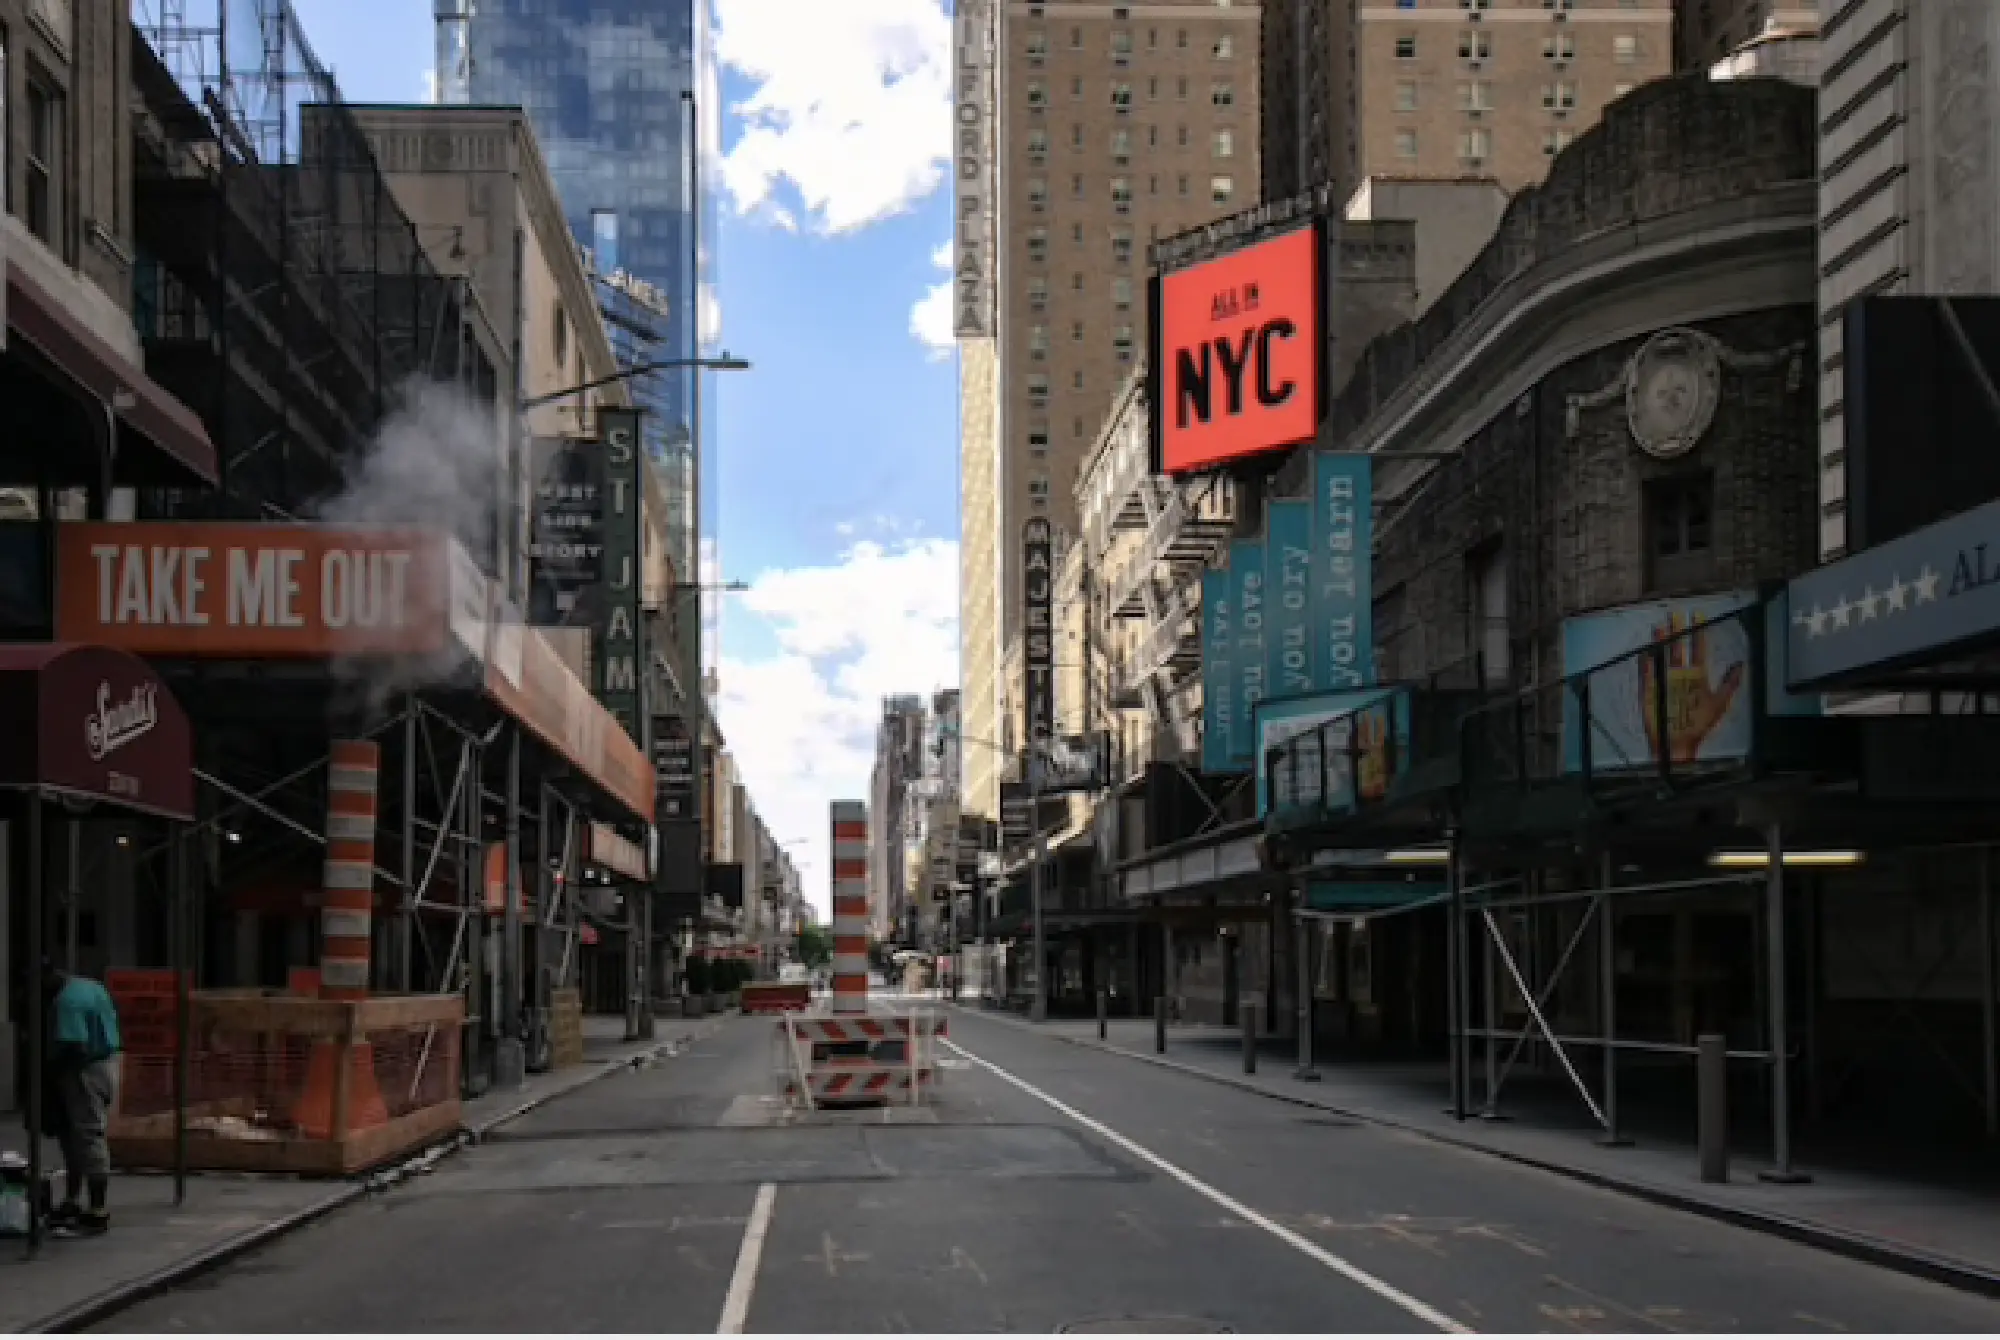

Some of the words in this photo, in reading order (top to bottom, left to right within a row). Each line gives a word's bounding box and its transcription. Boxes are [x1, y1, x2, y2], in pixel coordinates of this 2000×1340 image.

[956, 0, 982, 180] MILFORD
[956, 195, 983, 331] PLAZA
[1175, 317, 1297, 430] NYC
[90, 543, 212, 625] TAKE
[225, 547, 305, 627] ME
[320, 549, 411, 628] OUT
[1323, 475, 1356, 599] learn
[605, 556, 636, 713] JAM
[1238, 570, 1263, 648] love
[1282, 623, 1312, 690] you
[1329, 612, 1363, 687] you
[1242, 666, 1262, 719] ou
